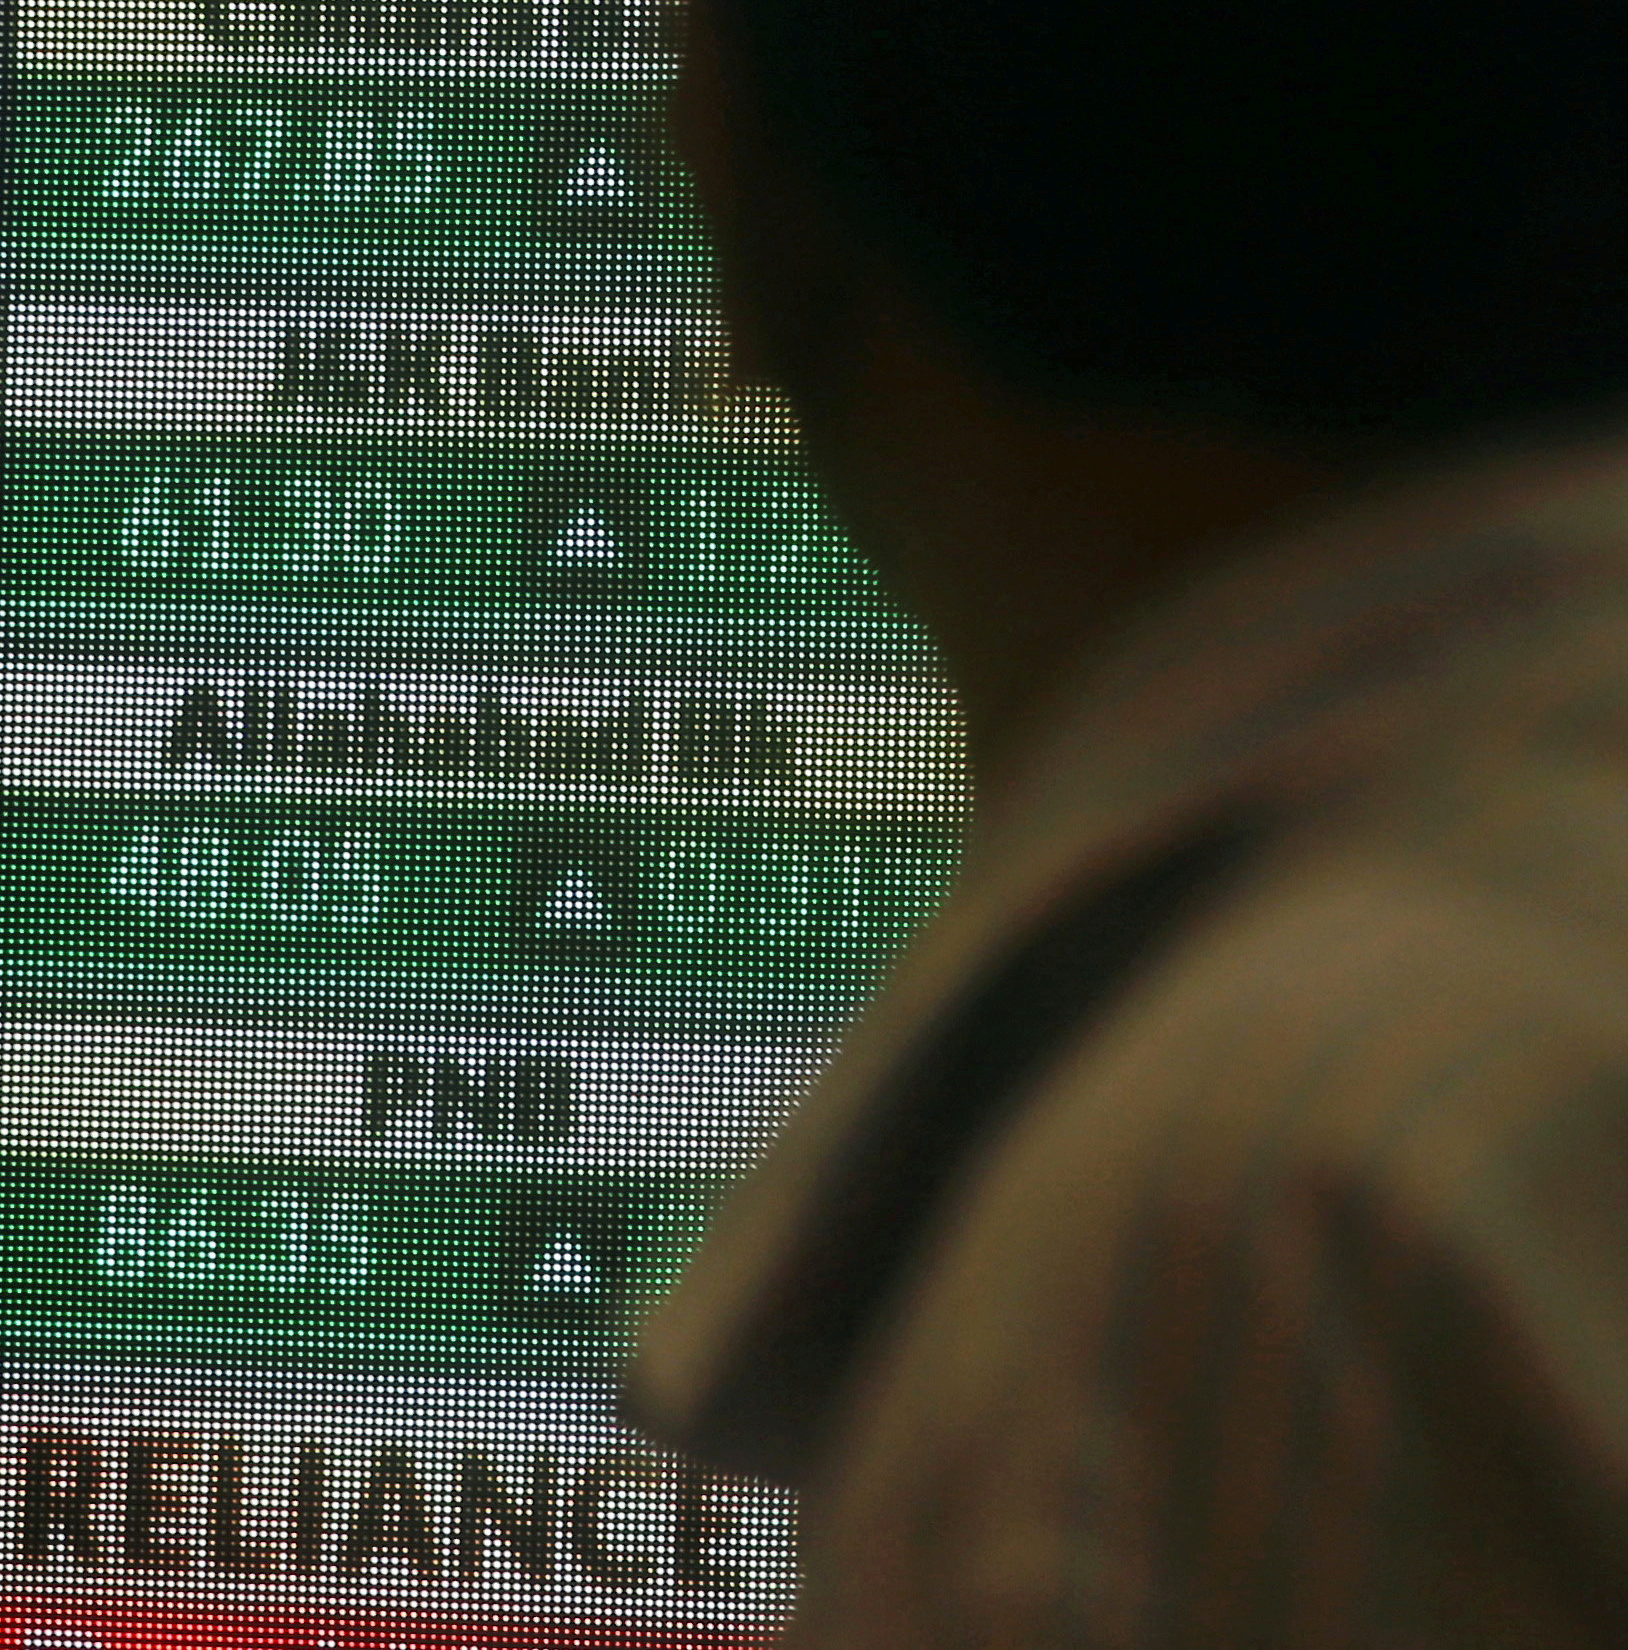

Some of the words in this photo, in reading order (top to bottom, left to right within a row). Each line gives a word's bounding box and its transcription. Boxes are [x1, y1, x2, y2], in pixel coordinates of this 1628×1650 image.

[100, 102, 443, 207] 267.85
[262, 321, 452, 418] J&K
[477, 326, 722, 422] Bank
[116, 469, 404, 581] 61.30
[162, 678, 648, 784] Allahabad
[673, 692, 798, 789] Bk
[104, 821, 387, 933] 48.05
[363, 1049, 577, 1145] PNB
[92, 1181, 377, 1294] 86.35
[17, 1427, 745, 1595] RELIANCE
